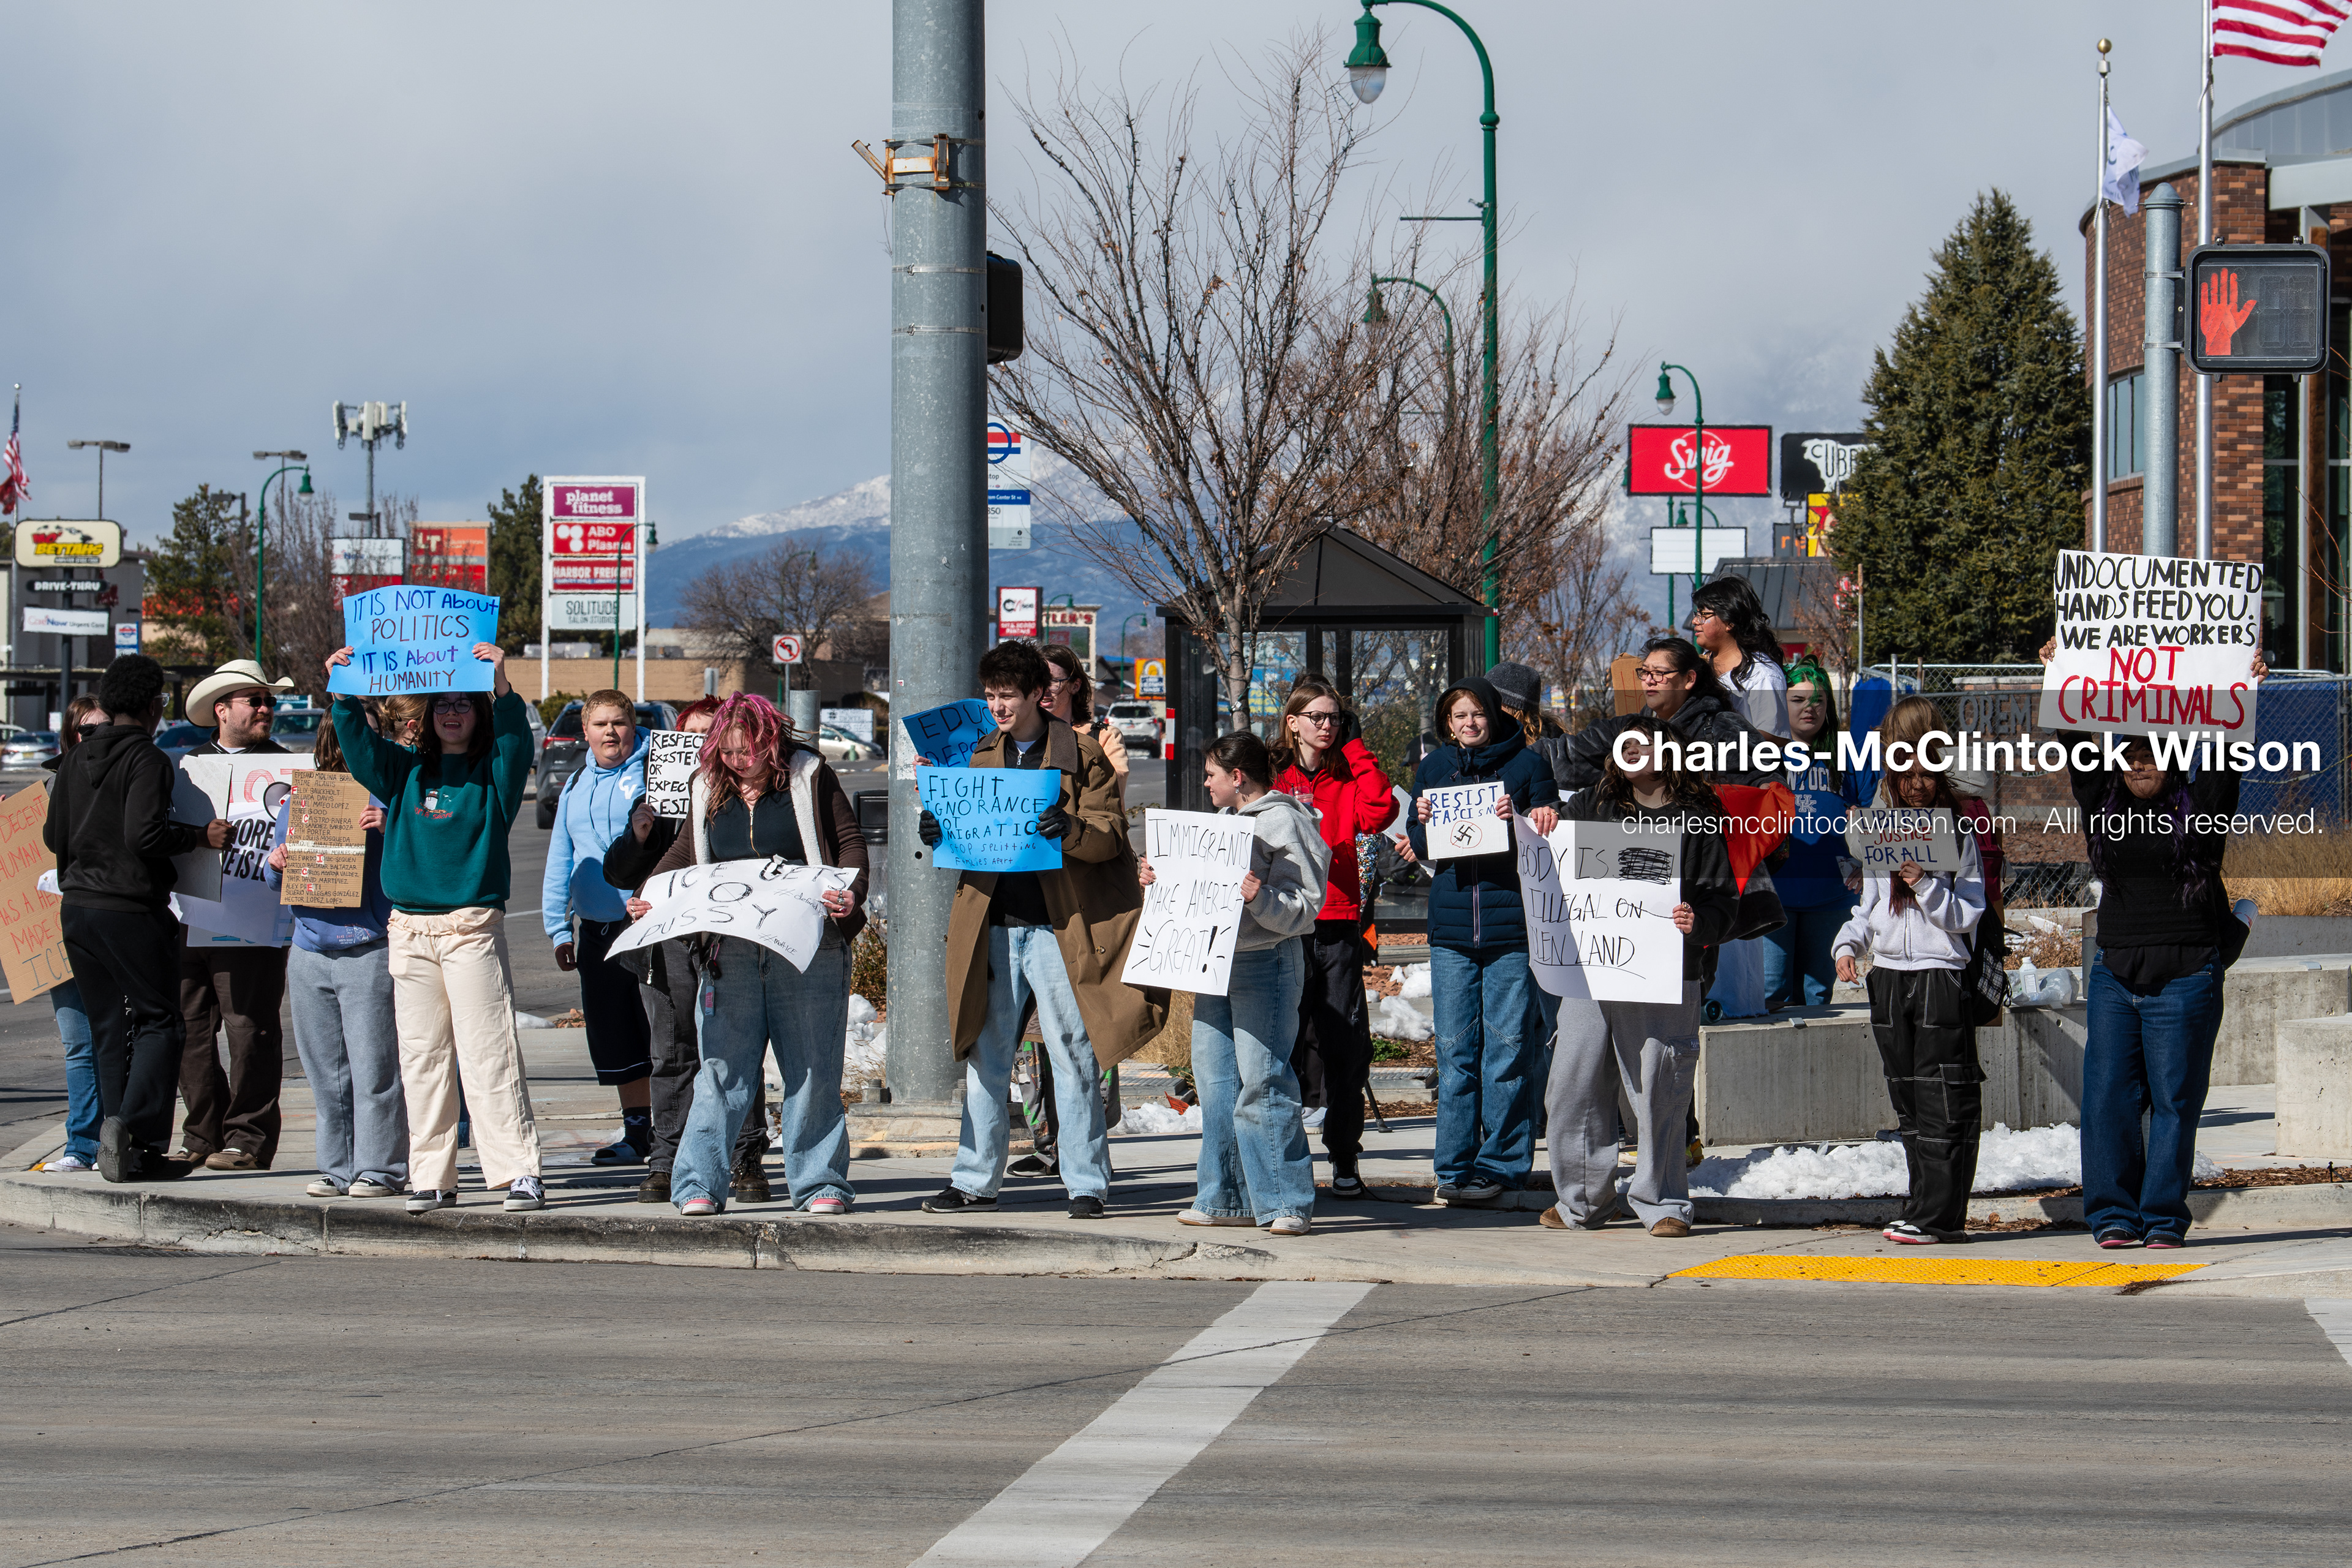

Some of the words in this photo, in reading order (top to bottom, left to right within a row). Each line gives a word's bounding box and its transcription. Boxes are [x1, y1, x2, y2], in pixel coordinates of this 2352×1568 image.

[565, 489, 614, 505] planet
[572, 502, 623, 514] fitness
[588, 526, 616, 537] ABO
[35, 543, 104, 555] BETTAHS
[588, 540, 631, 550] Plasma
[554, 567, 591, 578] HARBOR
[2054, 553, 2263, 593] UNDOCUMENTED
[34, 581, 100, 591] DRIVE-THRU
[354, 596, 366, 623] IT
[371, 592, 385, 616] IS
[396, 590, 435, 611] NOT
[442, 593, 499, 615] About
[566, 601, 617, 615] SOLITUDE
[2056, 590, 2129, 623] HANDS
[2133, 590, 2192, 620] FEED
[2195, 592, 2254, 621] YOU.
[27, 615, 67, 626] CareNow
[371, 615, 469, 644] POLITICS
[2060, 625, 2100, 650] WE
[2107, 624, 2147, 648] ARE
[2150, 622, 2257, 647] WORKERS
[363, 652, 377, 674] IT
[384, 650, 398, 671] IS
[406, 646, 458, 667] About
[2109, 646, 2185, 683] NOT
[369, 669, 456, 693] HUMANITY
[1960, 695, 2032, 734] OREM
[2058, 675, 2248, 730] CRIMINALS
[918, 704, 997, 739] EDUC
[652, 732, 704, 749] RESPECT
[649, 764, 662, 775] OR
[650, 749, 700, 766] EXISTEN
[291, 786, 308, 794] FELIX
[619, 775, 638, 799] CV
[648, 777, 688, 793] EXPEC
[929, 775, 1004, 801] FIGHT
[1430, 785, 1498, 809] RESIST
[648, 795, 690, 815] RESI
[925, 797, 1048, 816] IGNORANCE
[1433, 804, 1496, 826] FASCISM
[1795, 794, 1817, 813] UK
[0, 795, 47, 843] DECENT
[288, 827, 305, 835] KEITH
[938, 816, 960, 830] OT
[1860, 809, 1934, 829] LIBERTY
[1148, 819, 1250, 869] IMMIGRANTS
[1874, 827, 1932, 845] JUSTICE
[1520, 841, 1567, 882] BODY
[1576, 848, 1608, 879] IS
[1864, 845, 1898, 864] FOR
[1901, 845, 1937, 862] ALL
[668, 863, 733, 898] ICE
[22, 892, 34, 914] A
[1144, 882, 1180, 915] MAKE
[1528, 887, 1607, 923] ILLEGAL
[1616, 898, 1642, 918] ON
[10, 919, 54, 954] MADE
[637, 903, 778, 946] PUSSY
[1150, 920, 1218, 974] GREAT!
[1575, 930, 1635, 967] LAND
[22, 941, 73, 991] ICE
